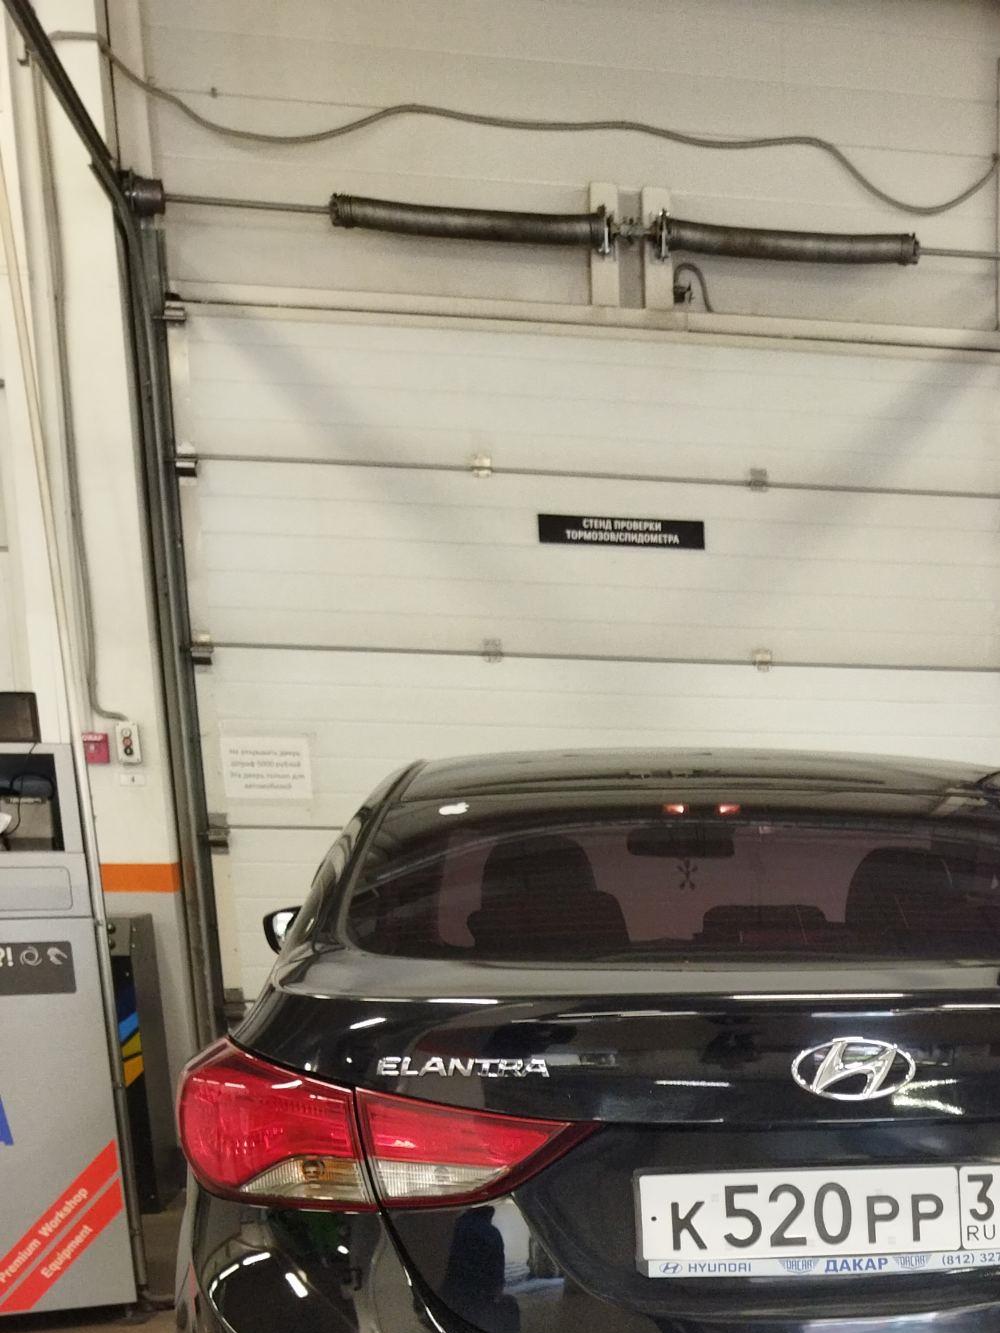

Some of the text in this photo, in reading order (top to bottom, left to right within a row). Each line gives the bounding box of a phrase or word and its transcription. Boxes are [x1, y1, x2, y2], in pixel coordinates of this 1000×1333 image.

[582, 518, 662, 532] СТЕНД ПРОВЕРКИ
[565, 529, 680, 545] ТОРМОЗОВ/СПИДОМЕТРА
[376, 1056, 550, 1078] ELANTRA
[0, 1187, 89, 1283] Premium Workshop
[40, 1223, 94, 1279] Equipment
[824, 1258, 889, 1273] ДАКАР
[942, 1254, 975, 1267] (812)
[688, 1262, 752, 1275] HYUNDAI
